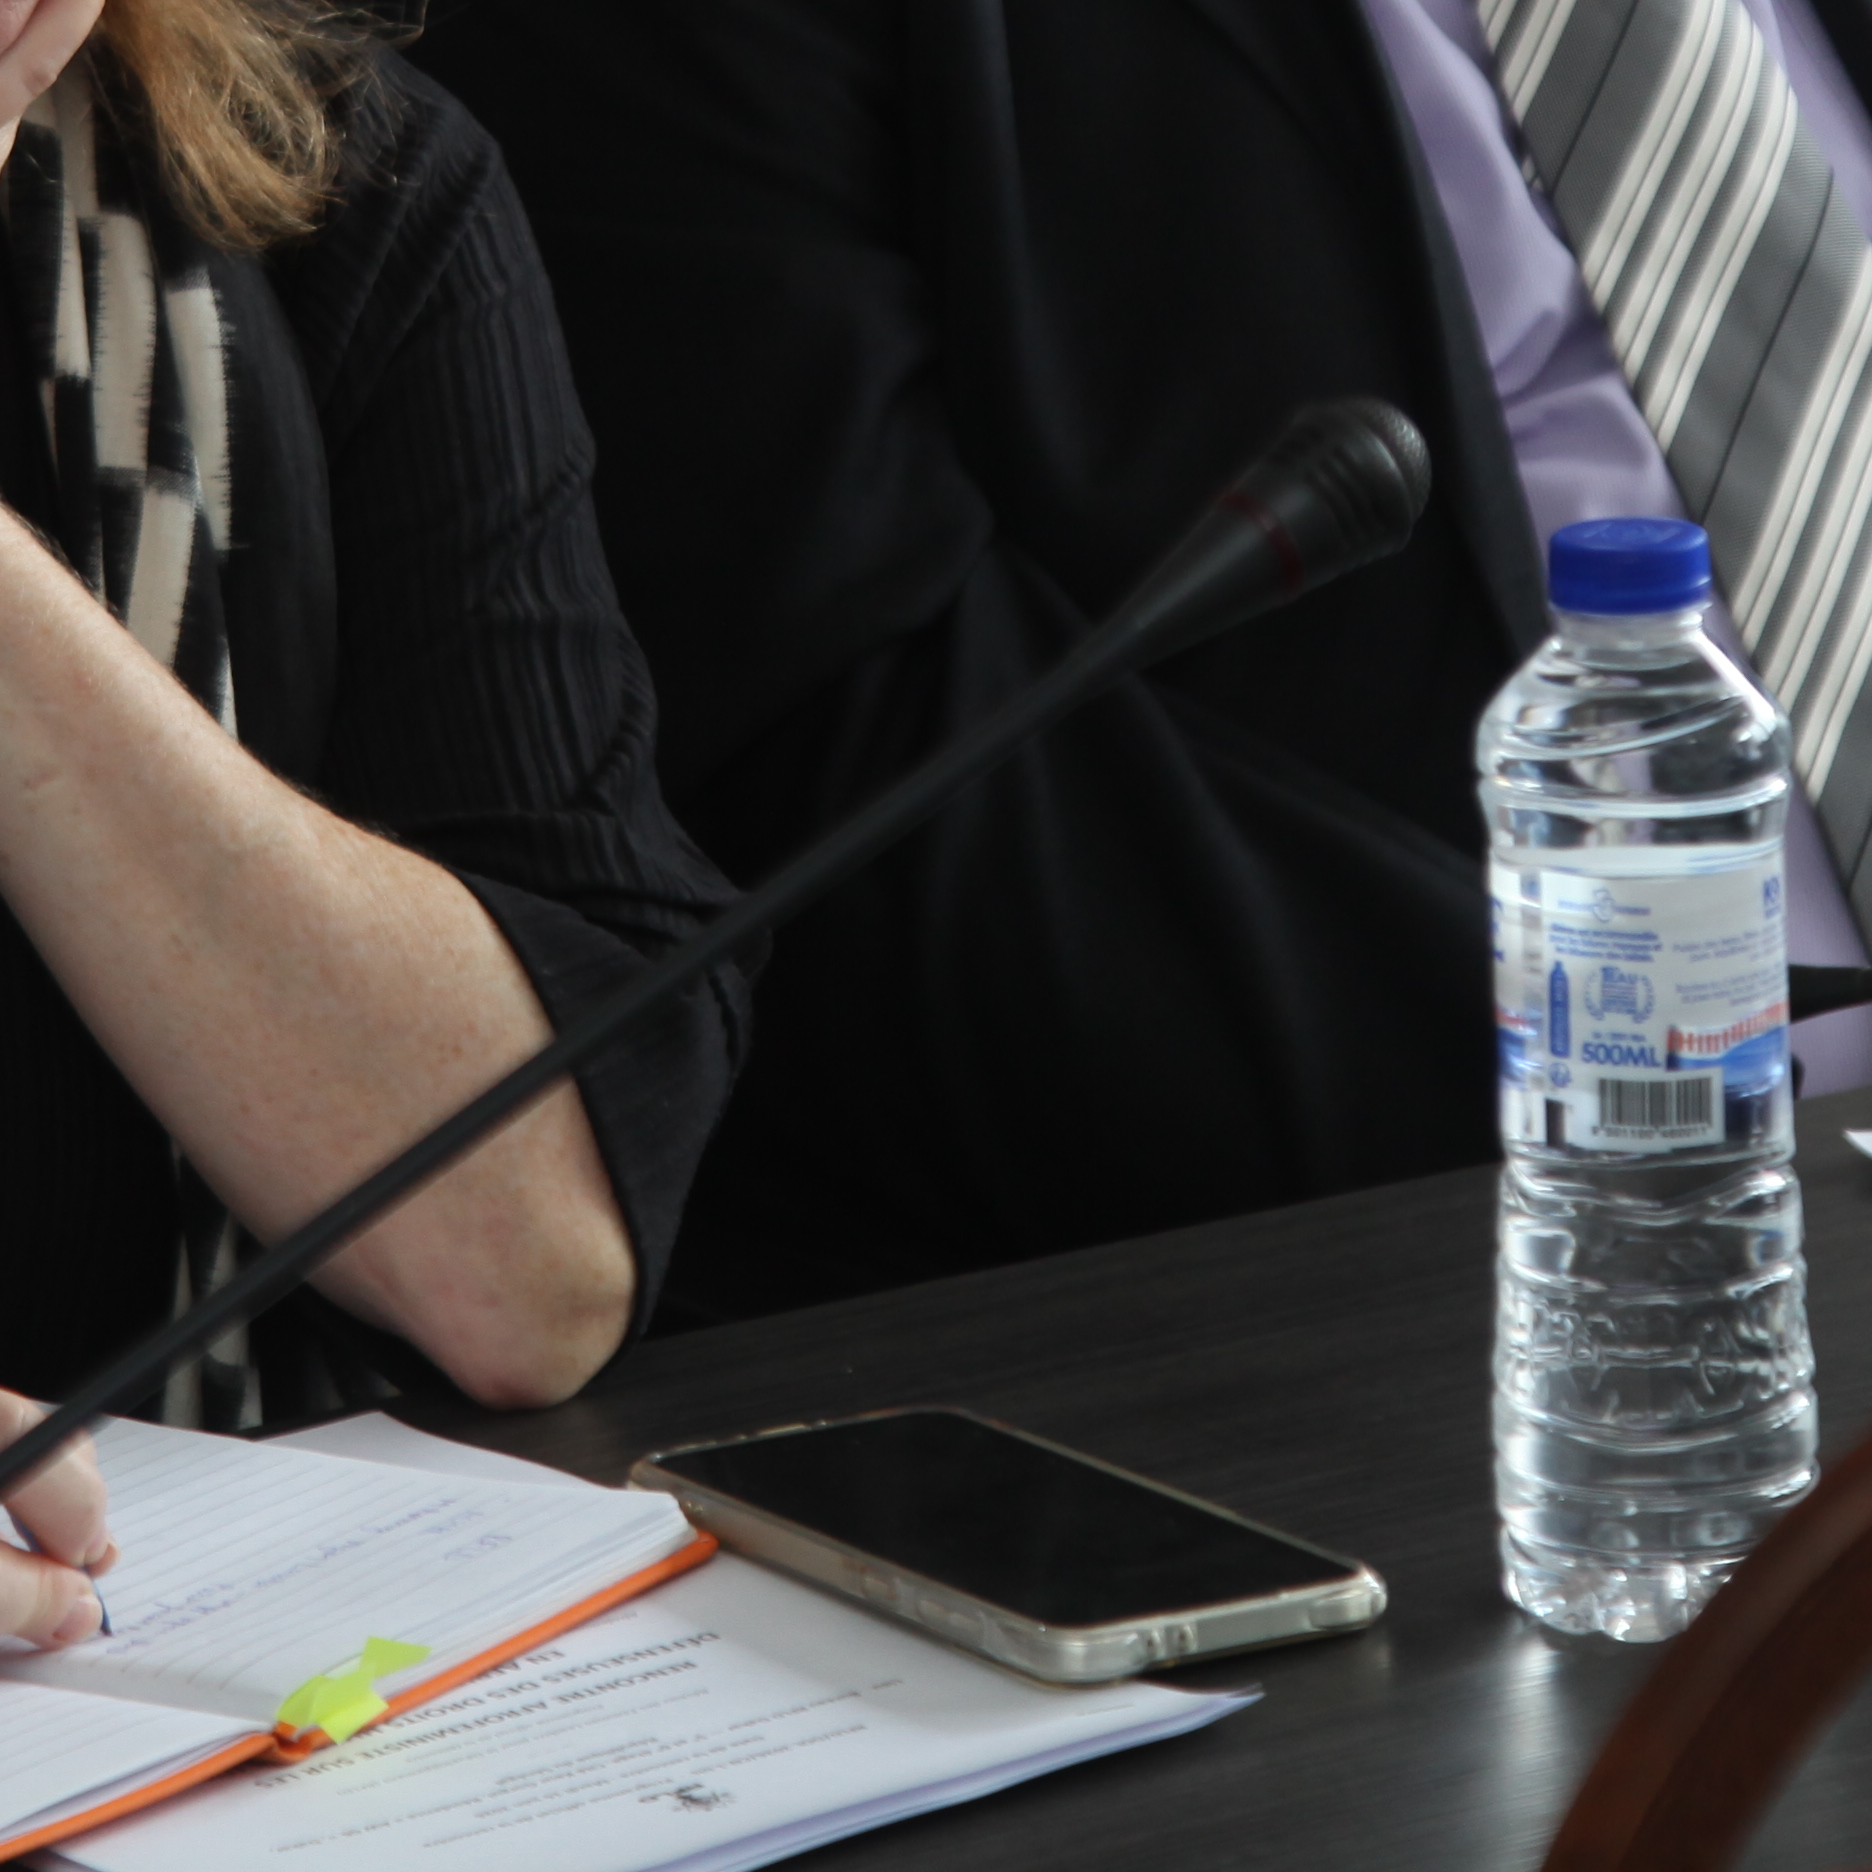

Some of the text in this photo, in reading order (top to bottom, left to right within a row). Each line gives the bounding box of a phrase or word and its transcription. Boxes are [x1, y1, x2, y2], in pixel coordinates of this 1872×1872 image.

[1581, 1042, 1662, 1068] 500ML
[525, 1649, 566, 1665] EN
[387, 1631, 721, 1728] DÉFENSEUSES DES DROITS
[549, 1661, 699, 1704] RENCONTRE
